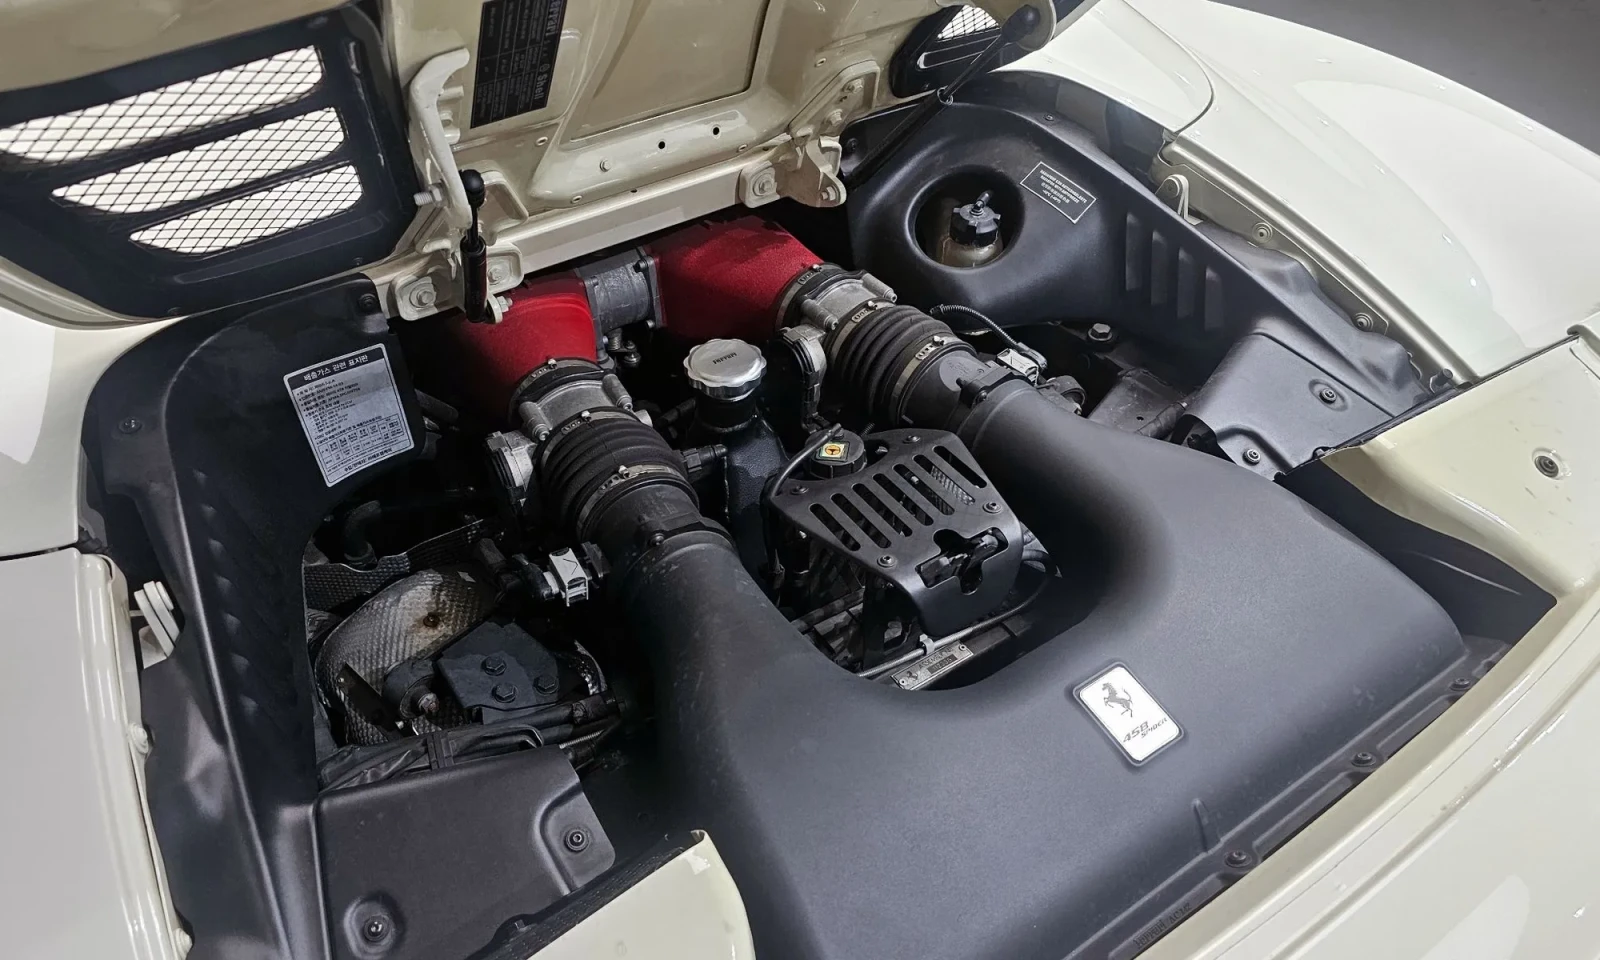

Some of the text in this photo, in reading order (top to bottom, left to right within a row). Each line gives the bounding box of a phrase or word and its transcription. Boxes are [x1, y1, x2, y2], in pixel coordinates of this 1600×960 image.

[545, 0, 563, 36] errari
[534, 73, 548, 100] Shell
[303, 367, 331, 381] 배출가스
[332, 361, 347, 372] 관련
[1123, 721, 1149, 743] 458
